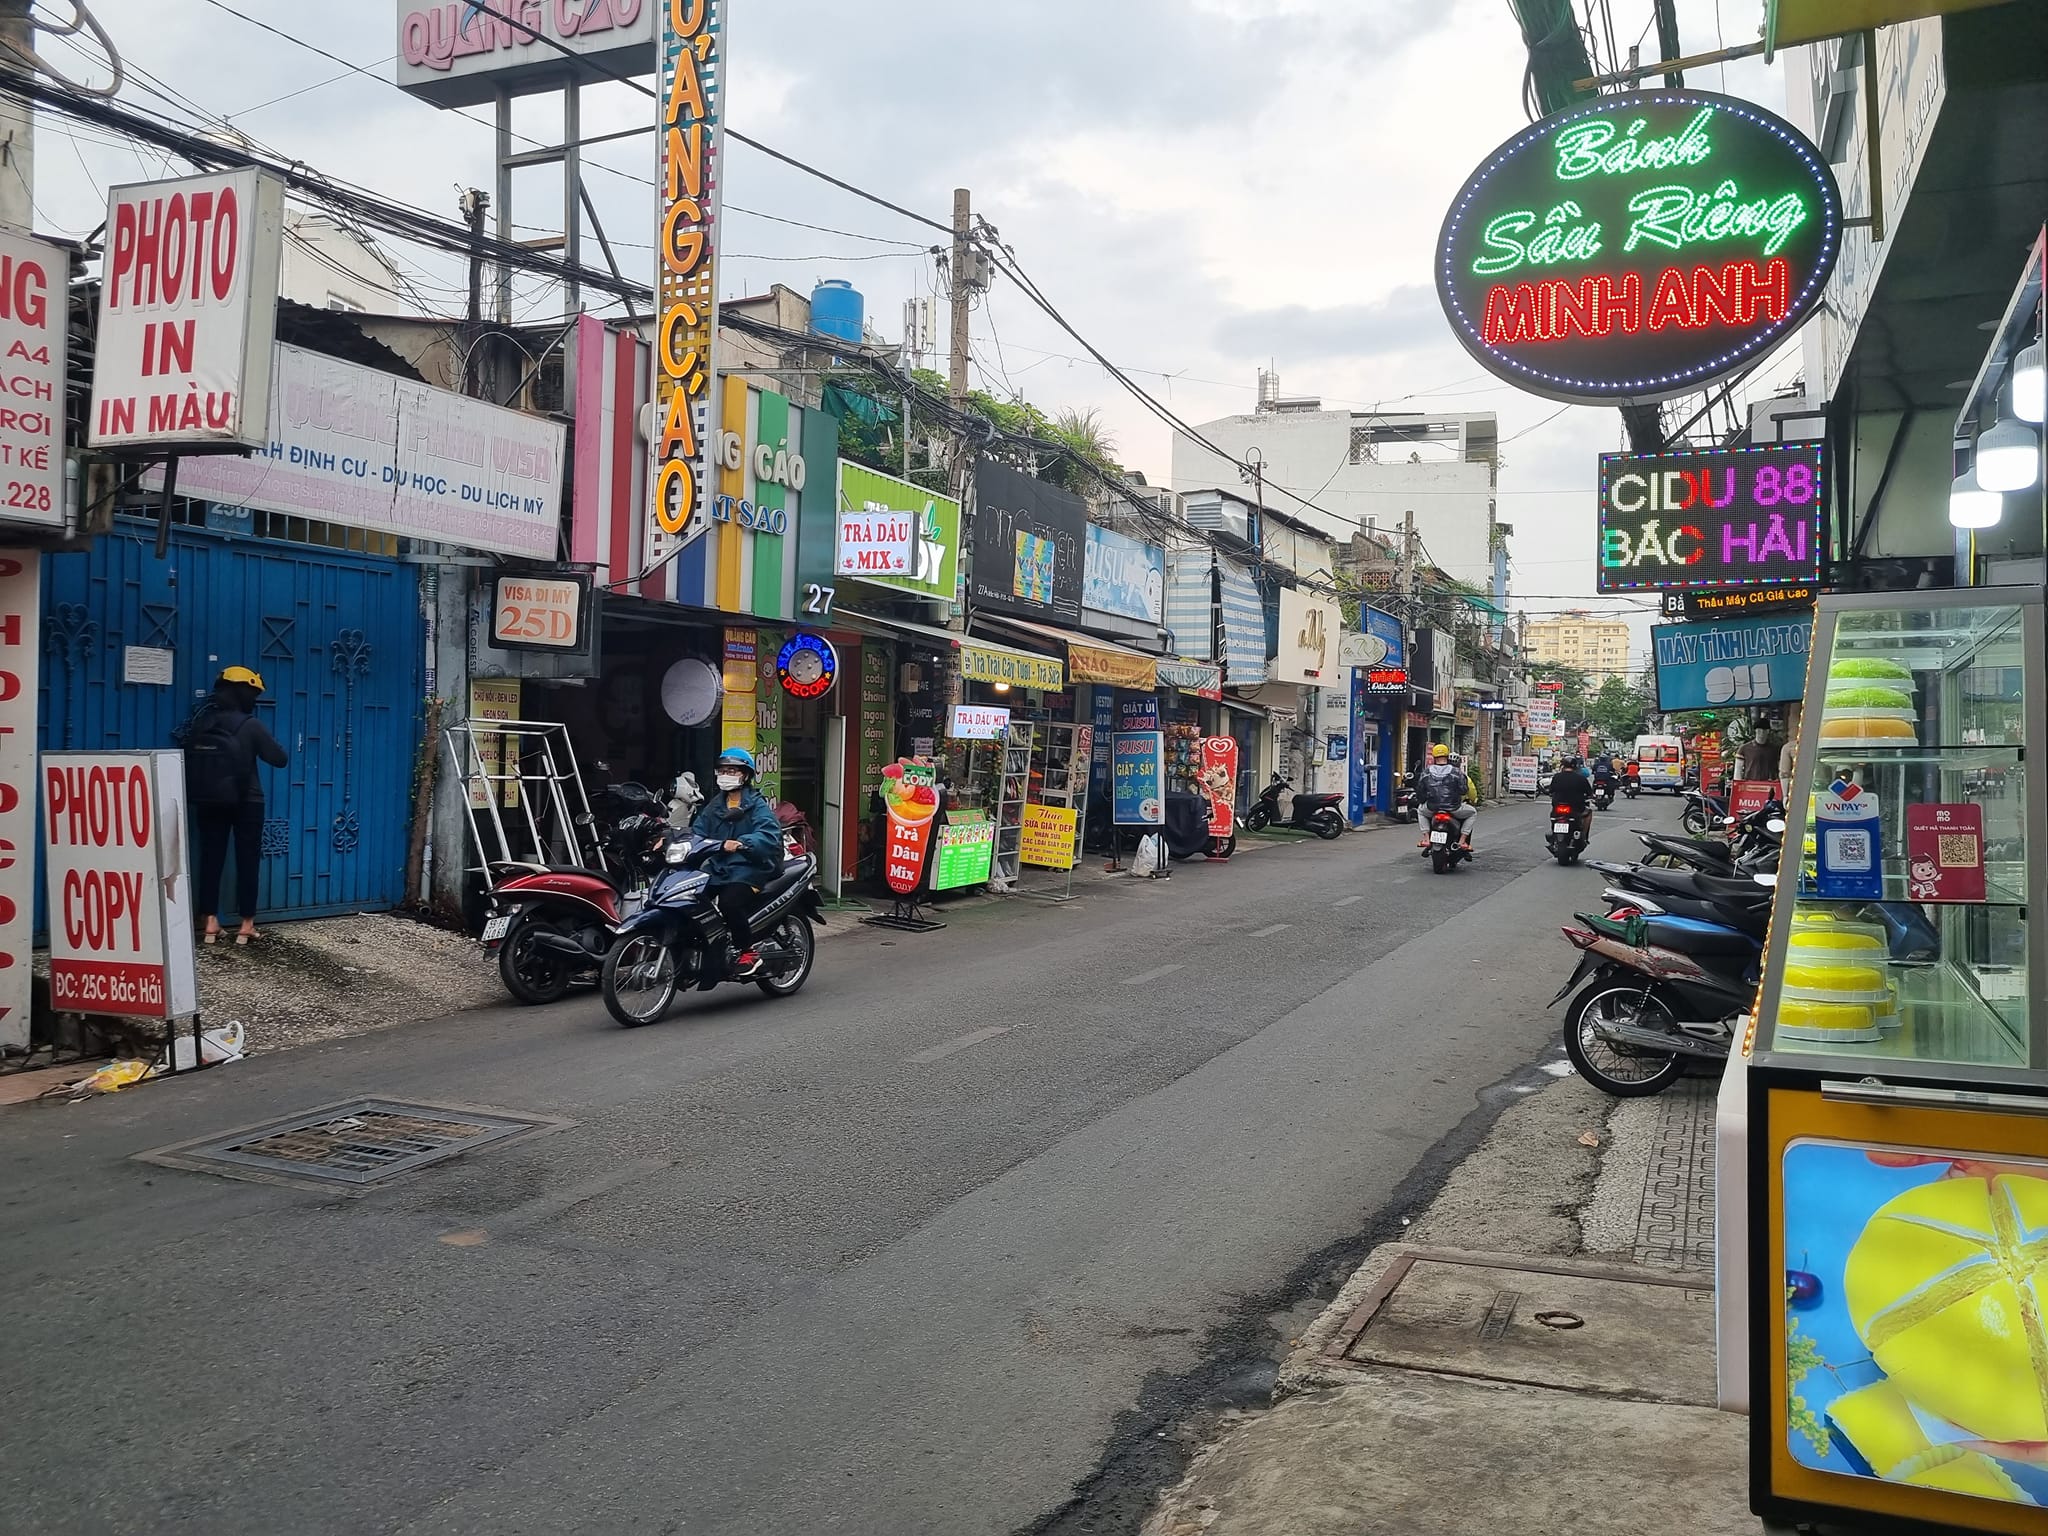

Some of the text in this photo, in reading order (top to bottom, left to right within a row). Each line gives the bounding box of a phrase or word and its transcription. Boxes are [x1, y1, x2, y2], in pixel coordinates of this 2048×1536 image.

[1555, 107, 1714, 180] Bánh
[1472, 180, 1807, 274] Sầu Riêng
[110, 187, 238, 308] PHOTO
[1484, 260, 1786, 345] MINH ANH
[7, 340, 50, 365] A4
[141, 320, 196, 376] IN
[100, 382, 231, 436] IN MÀU
[290, 446, 335, 471] ĐỊNH
[342, 457, 368, 478] CƯ
[383, 466, 407, 487] DU
[413, 475, 447, 495] HỌC
[462, 484, 482, 503] DU
[487, 488, 519, 512] LỊCH
[524, 496, 544, 516] MỸ
[754, 438, 806, 492] CÁO
[1611, 463, 1814, 512] CIDU 88
[844, 518, 908, 543] TRÀ DÂU
[1722, 512, 1808, 564] HẢI
[857, 551, 891, 570] MIX
[504, 586, 572, 605] VISA ĐI MỸ
[809, 583, 835, 615] 27
[1726, 594, 1747, 607] Máy
[500, 606, 572, 640] 25D
[1658, 632, 1698, 667] MÁY
[1701, 628, 1745, 663] TÍNH
[973, 652, 985, 674] Trà
[987, 654, 1000, 676] Trái
[1002, 657, 1015, 680] Cây
[783, 677, 830, 698] DECOR
[757, 696, 778, 730] Thế
[958, 711, 1007, 726] TRÀ DÂU MIX
[1122, 699, 1155, 717] GIẶT ỦI
[1122, 716, 1156, 730] SUSU
[756, 743, 778, 784] giới
[1116, 739, 1155, 756] SUSU
[1116, 761, 1135, 780] GIẶT
[47, 765, 150, 848] PHOTO
[1739, 799, 1761, 807] MUA
[895, 825, 919, 842] Trà
[892, 844, 920, 862] Dâu
[890, 864, 915, 881] Mix
[64, 868, 143, 952] COPY
[56, 970, 163, 1005] ĐC: 25C Bắc Hải
